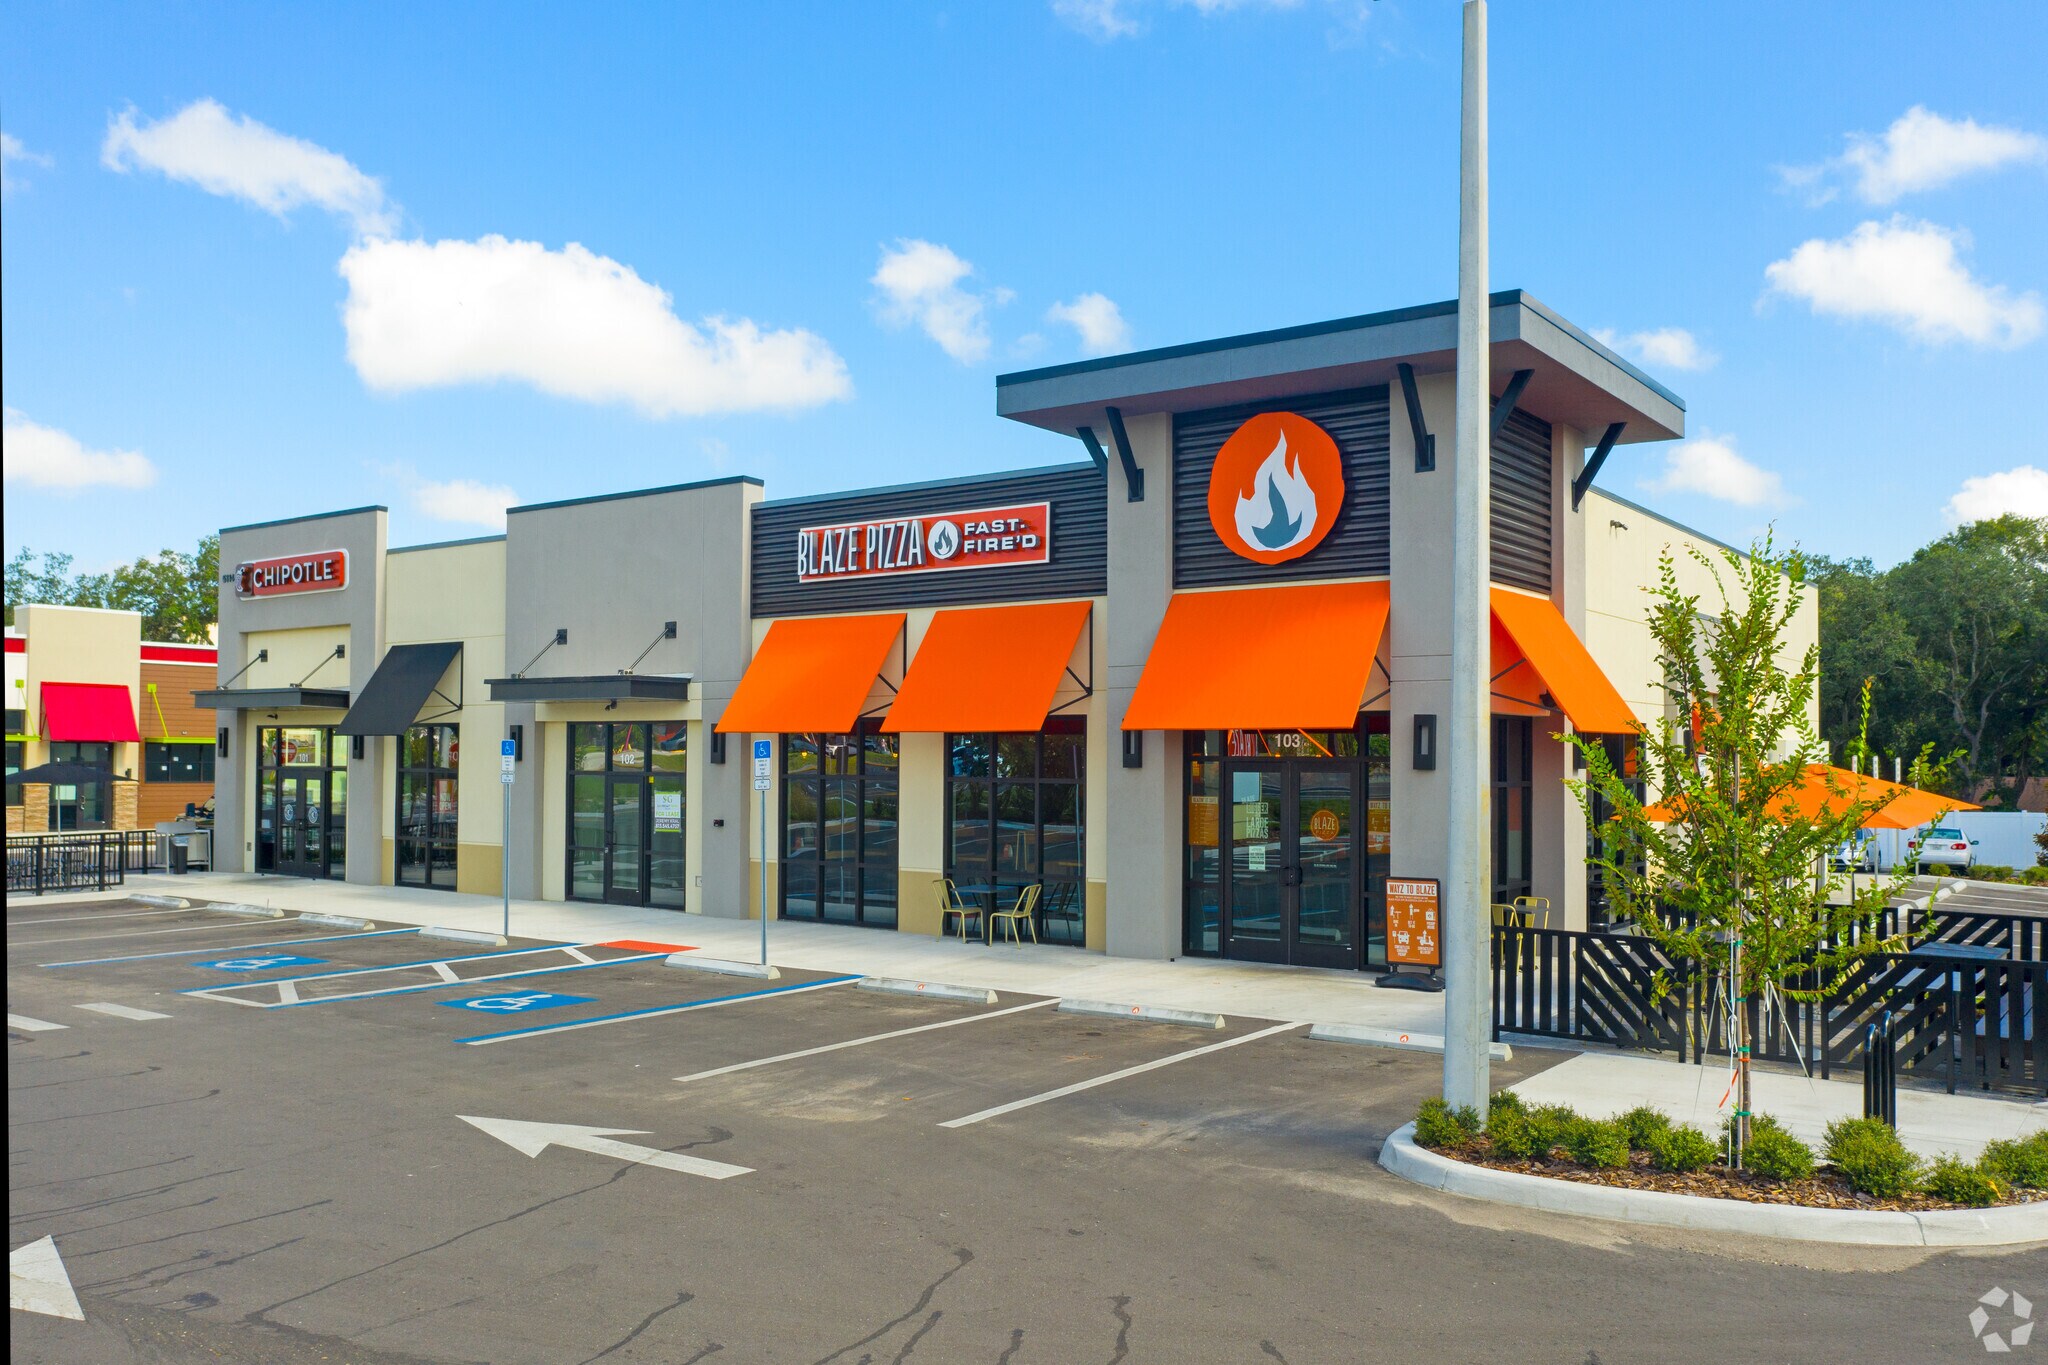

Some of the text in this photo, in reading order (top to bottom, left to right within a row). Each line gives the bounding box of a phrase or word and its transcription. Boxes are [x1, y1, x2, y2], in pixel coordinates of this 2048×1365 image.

[797, 519, 924, 576] BLAZE PIZZA
[963, 533, 1038, 554] FIRE'D
[253, 559, 332, 588] CHIPOTLE
[1275, 733, 1300, 748] 103
[299, 753, 309, 762] 101
[620, 754, 635, 765] 102
[1314, 816, 1335, 830] BLAZE
[1389, 883, 1436, 895] WAYZ TO BLAZE
